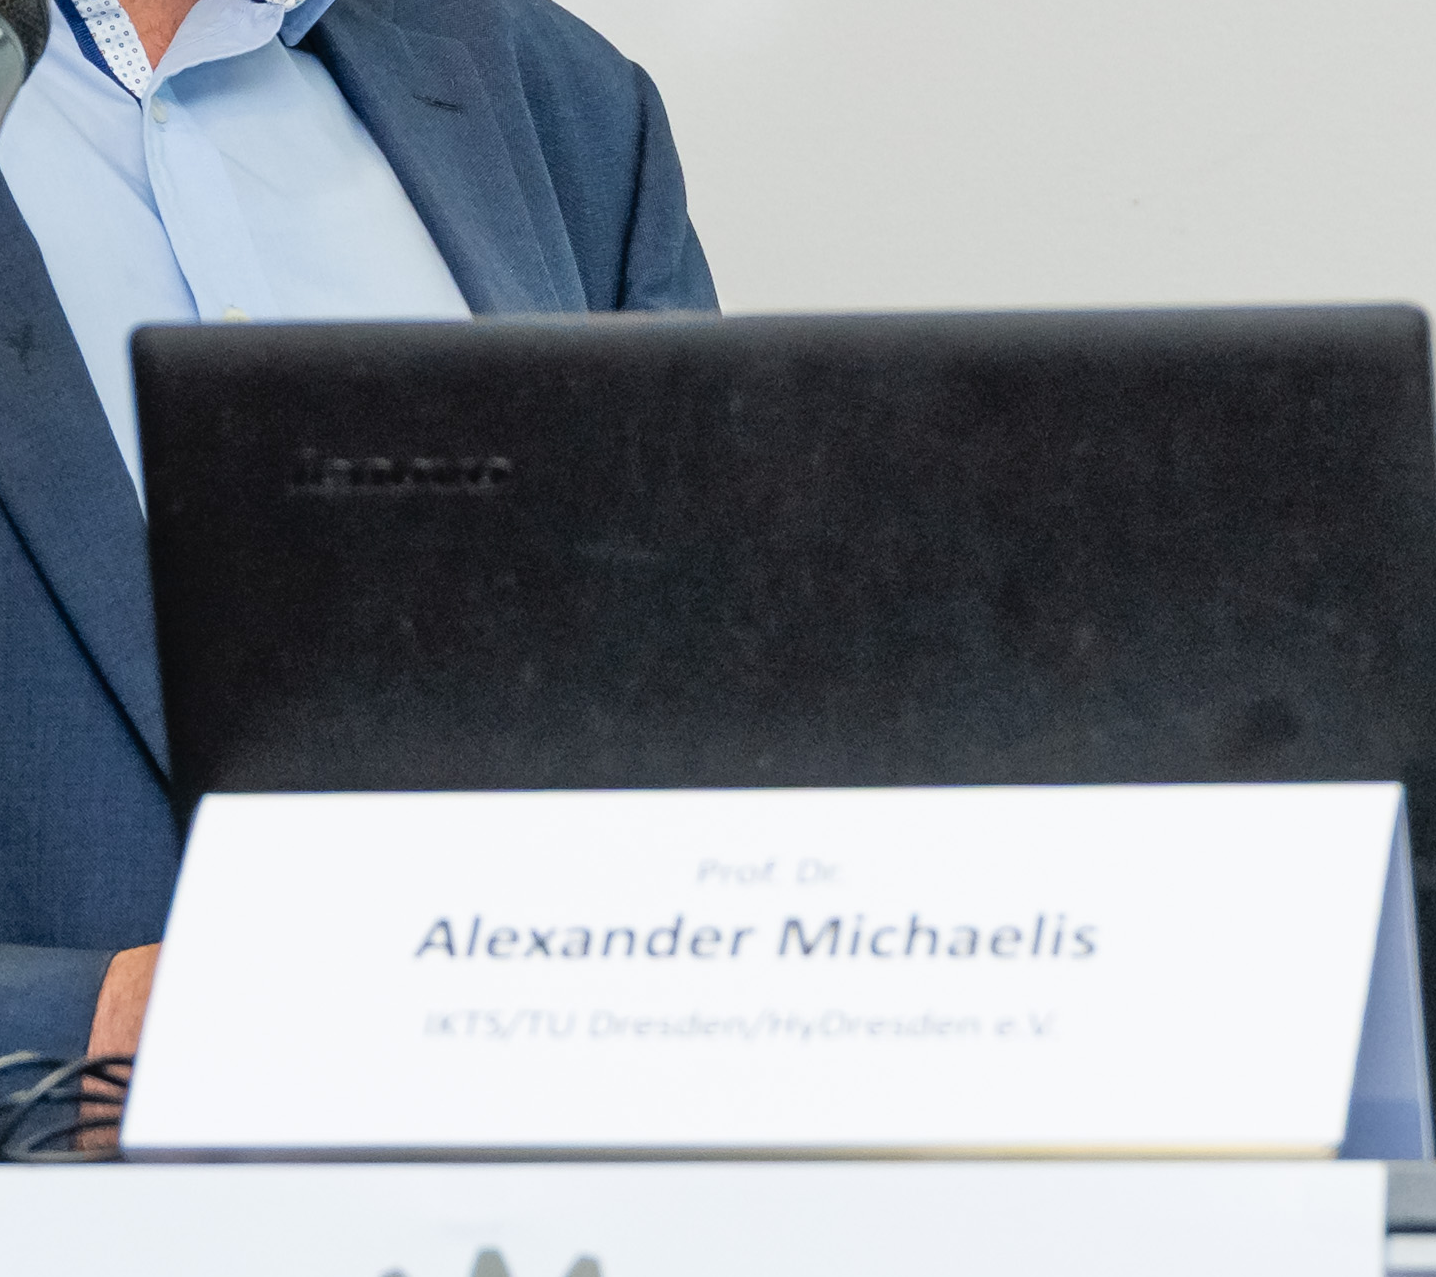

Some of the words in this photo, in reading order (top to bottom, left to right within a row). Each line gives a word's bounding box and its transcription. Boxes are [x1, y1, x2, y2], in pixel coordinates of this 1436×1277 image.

[413, 913, 753, 961] Alexander
[776, 912, 1098, 961] Michaelis
[585, 1007, 984, 1046] Dresden/HyDresden
